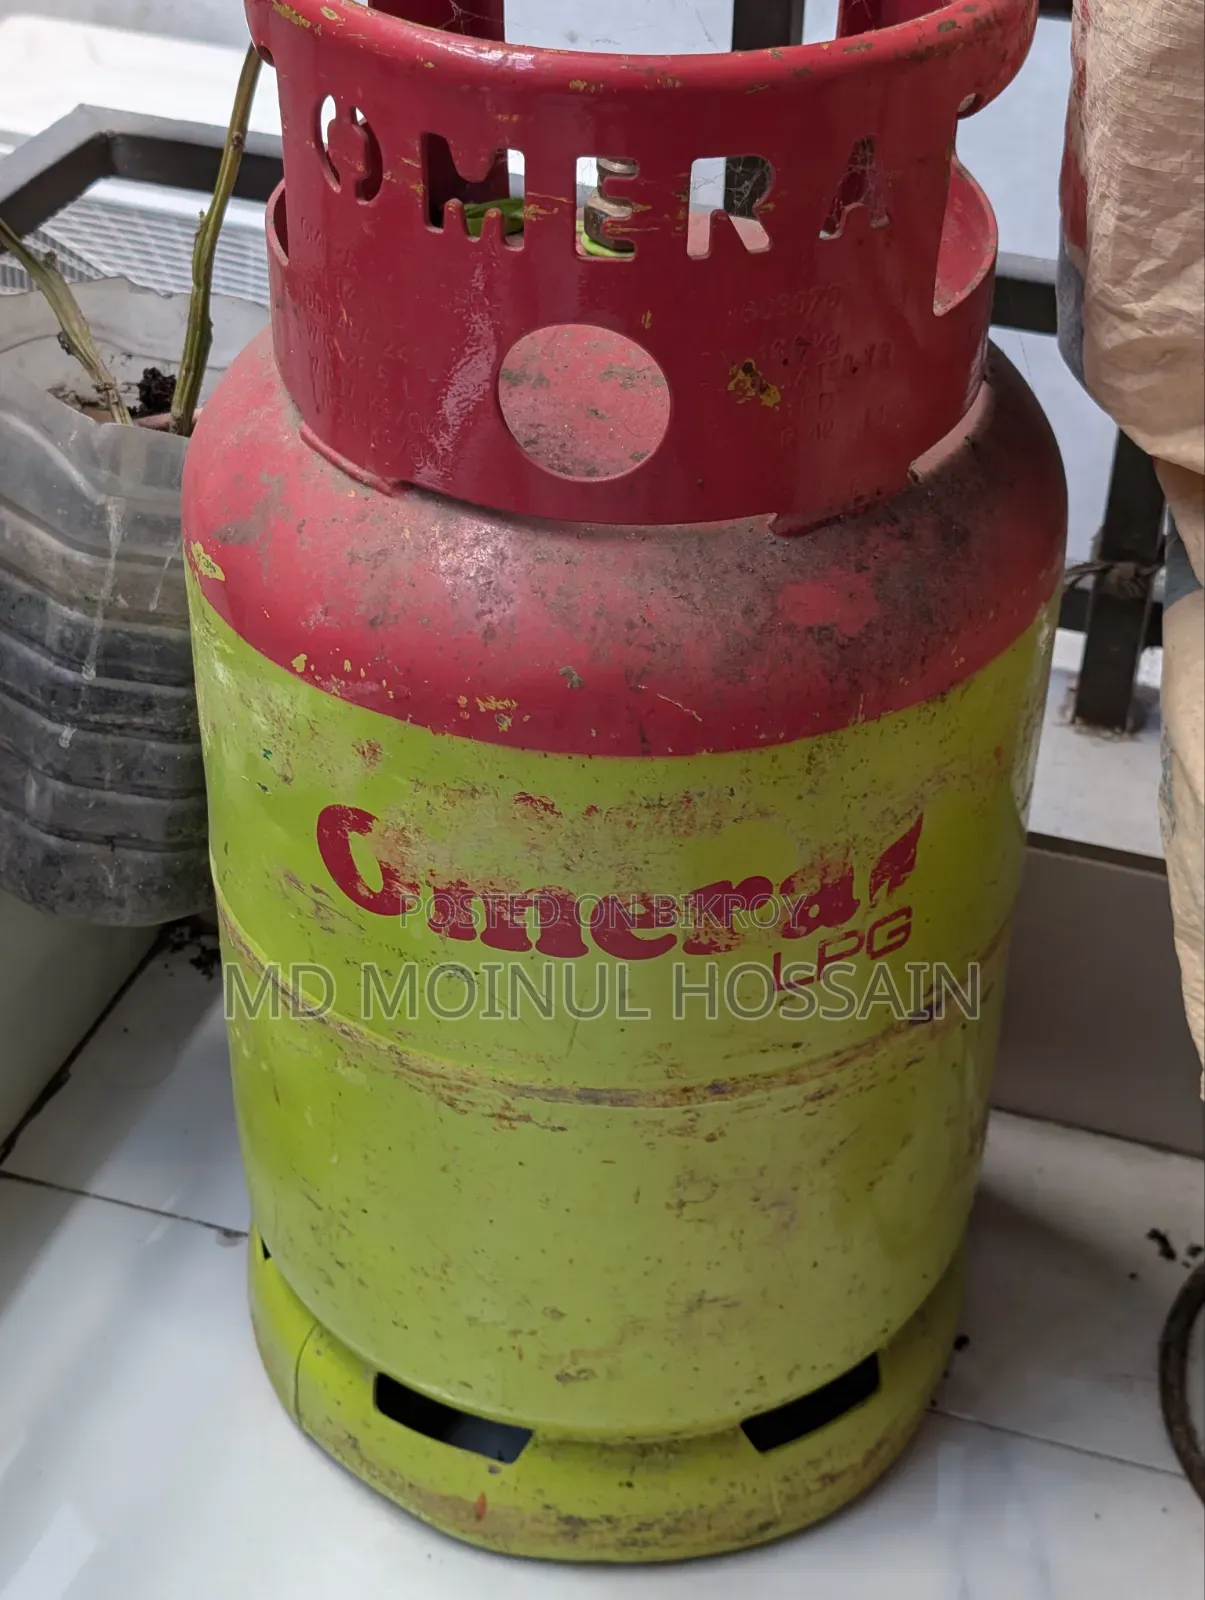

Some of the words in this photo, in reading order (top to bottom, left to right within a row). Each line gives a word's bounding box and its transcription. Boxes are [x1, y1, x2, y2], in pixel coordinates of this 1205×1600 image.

[316, 93, 892, 260] OMERA
[317, 804, 860, 960] Omera
[772, 905, 913, 992] LPG
